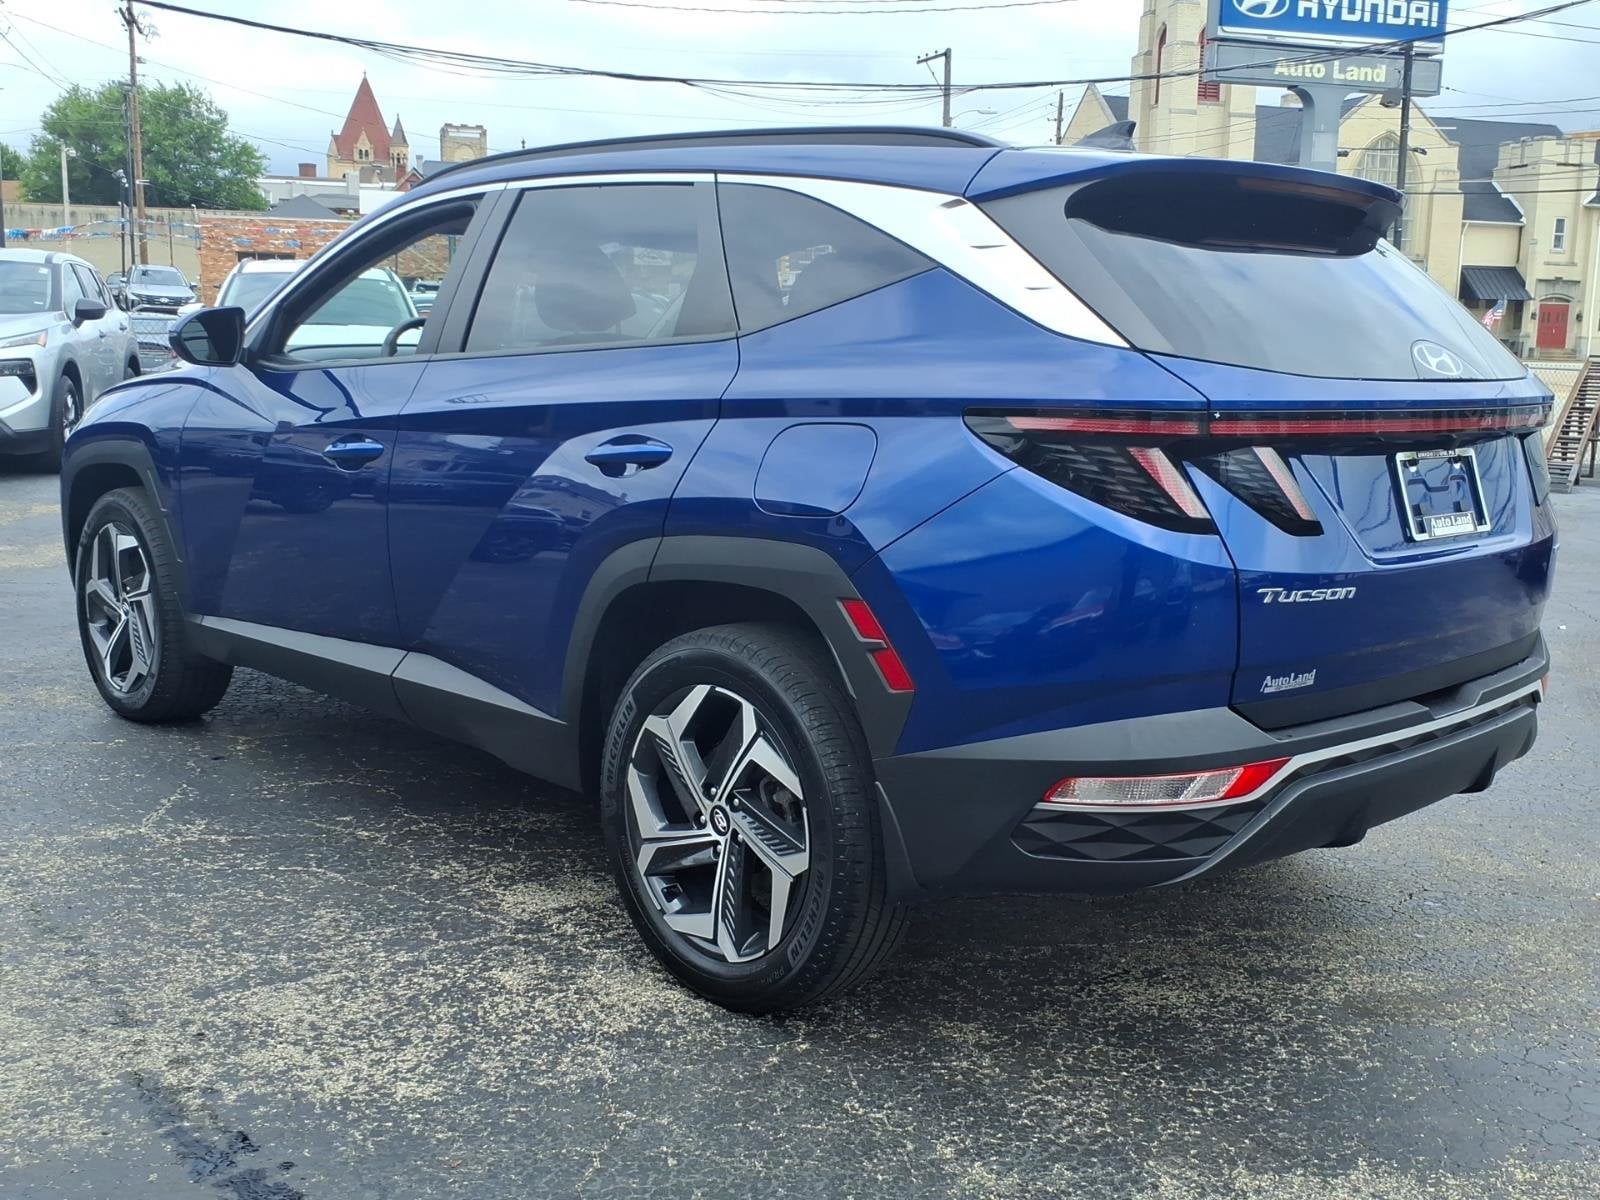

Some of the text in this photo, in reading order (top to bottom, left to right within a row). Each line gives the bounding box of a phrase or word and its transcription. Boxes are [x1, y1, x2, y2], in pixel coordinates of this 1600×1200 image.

[1297, 0, 1439, 27] HYUNDAI
[1274, 59, 1387, 83] Auto Land
[1260, 669, 1317, 692] AutoLand
[607, 700, 635, 784] MICHELIN
[791, 869, 825, 962] MICHELIN
